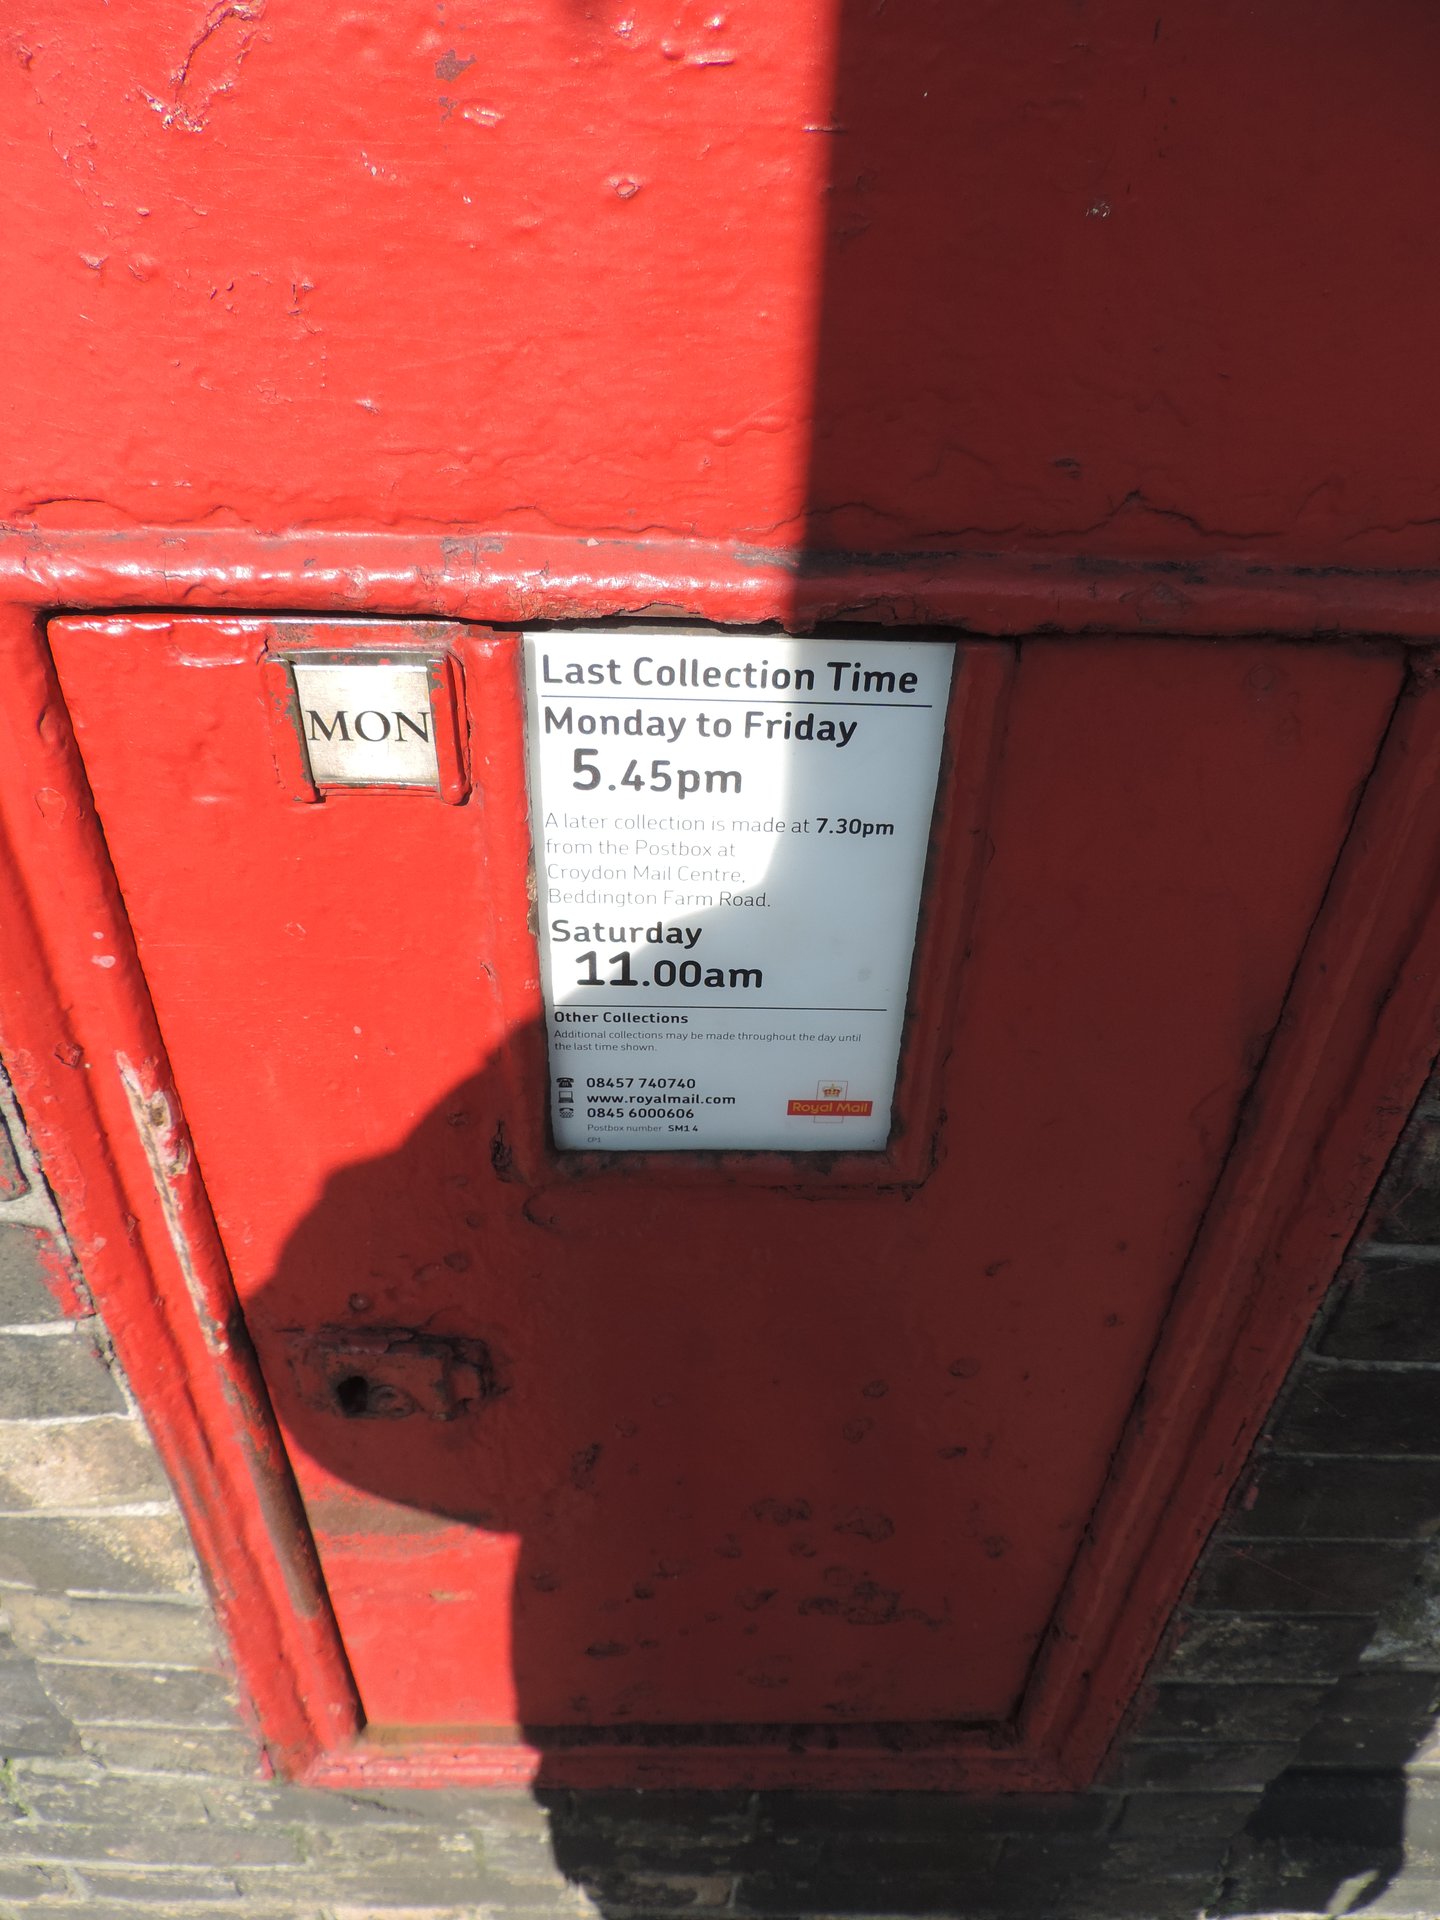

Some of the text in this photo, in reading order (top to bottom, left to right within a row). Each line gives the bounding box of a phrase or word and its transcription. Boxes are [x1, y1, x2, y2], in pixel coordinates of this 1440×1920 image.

[543, 654, 918, 693] Last Collection Time
[305, 710, 430, 743] MON
[544, 706, 858, 748] Monday to Friday
[572, 748, 742, 800] 5.45pm
[545, 812, 895, 838] A later collection is made at 7.30pm
[545, 838, 736, 857] from the Postbox at
[547, 863, 745, 883] Croydon Mail Centre,
[548, 888, 771, 907] Beddington Farm Road.
[551, 919, 702, 949] Saturday
[575, 951, 763, 988] 11.00am
[554, 1011, 689, 1024] Other Collections
[554, 1030, 862, 1043] Additional collections may be made throughout the day until
[554, 1042, 657, 1051] the last time shown.
[586, 1077, 696, 1089] 08457 740740
[586, 1093, 736, 1106] www.royalmail.com
[792, 1102, 868, 1114] Royal Mail
[587, 1107, 694, 1119] 0845 6000606
[587, 1124, 624, 1132] Postbox
[626, 1124, 662, 1132] number
